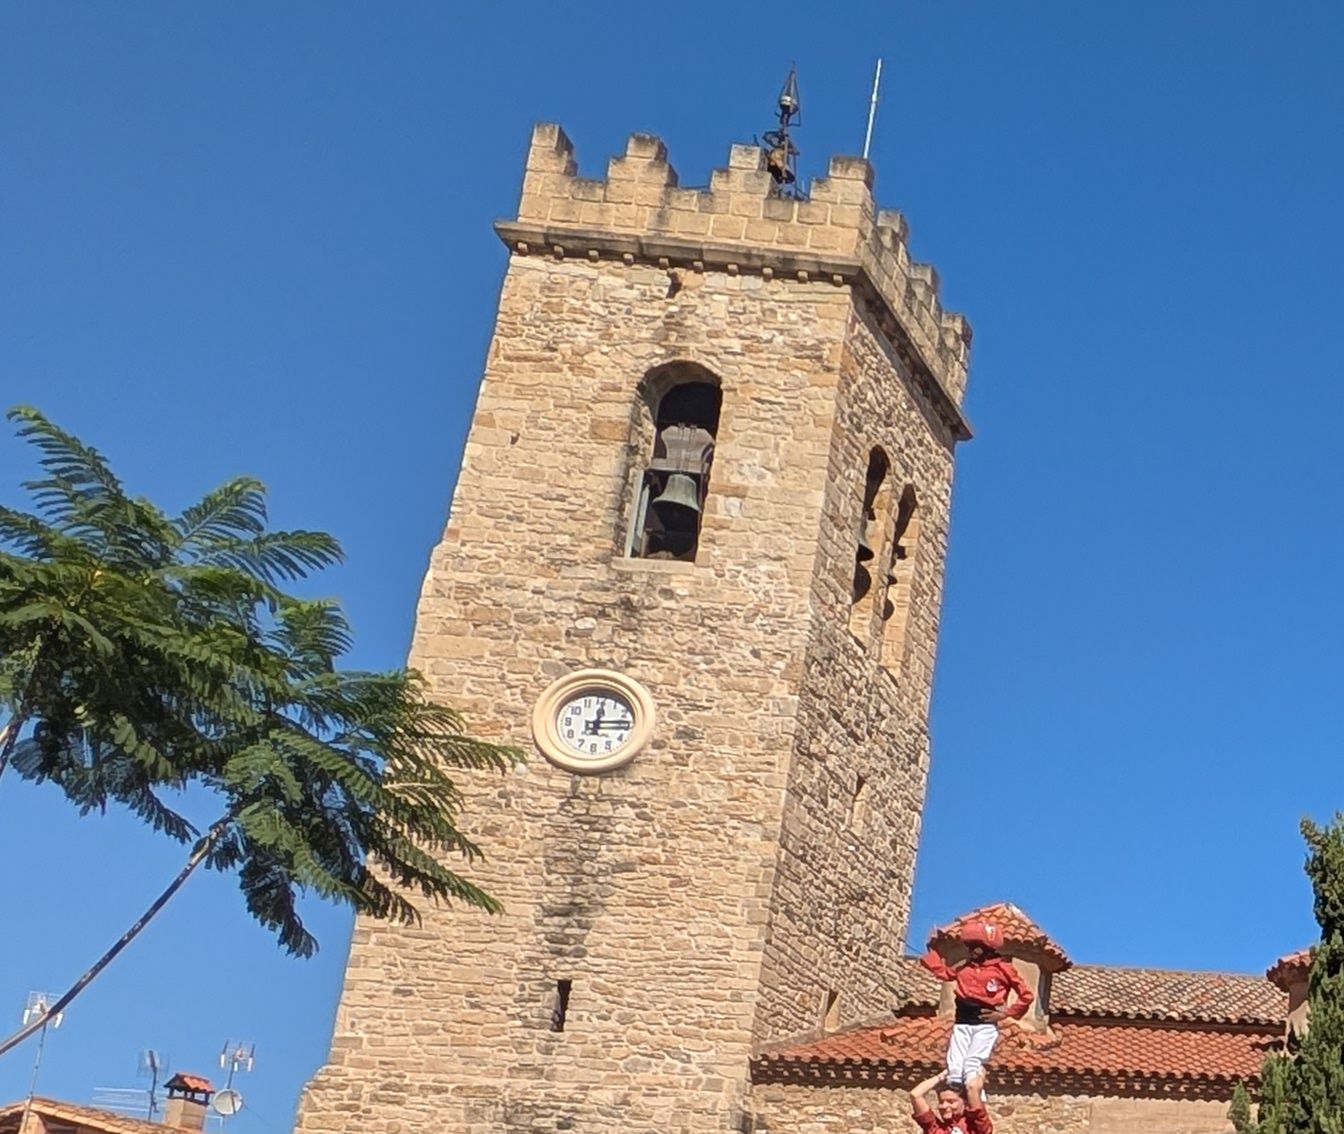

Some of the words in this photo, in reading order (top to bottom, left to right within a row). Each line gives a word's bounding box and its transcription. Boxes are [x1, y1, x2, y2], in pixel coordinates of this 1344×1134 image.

[584, 699, 592, 708] 11
[571, 706, 582, 715] 10
[565, 717, 572, 726] 9
[578, 739, 585, 748] 7
[604, 740, 612, 750] 5
